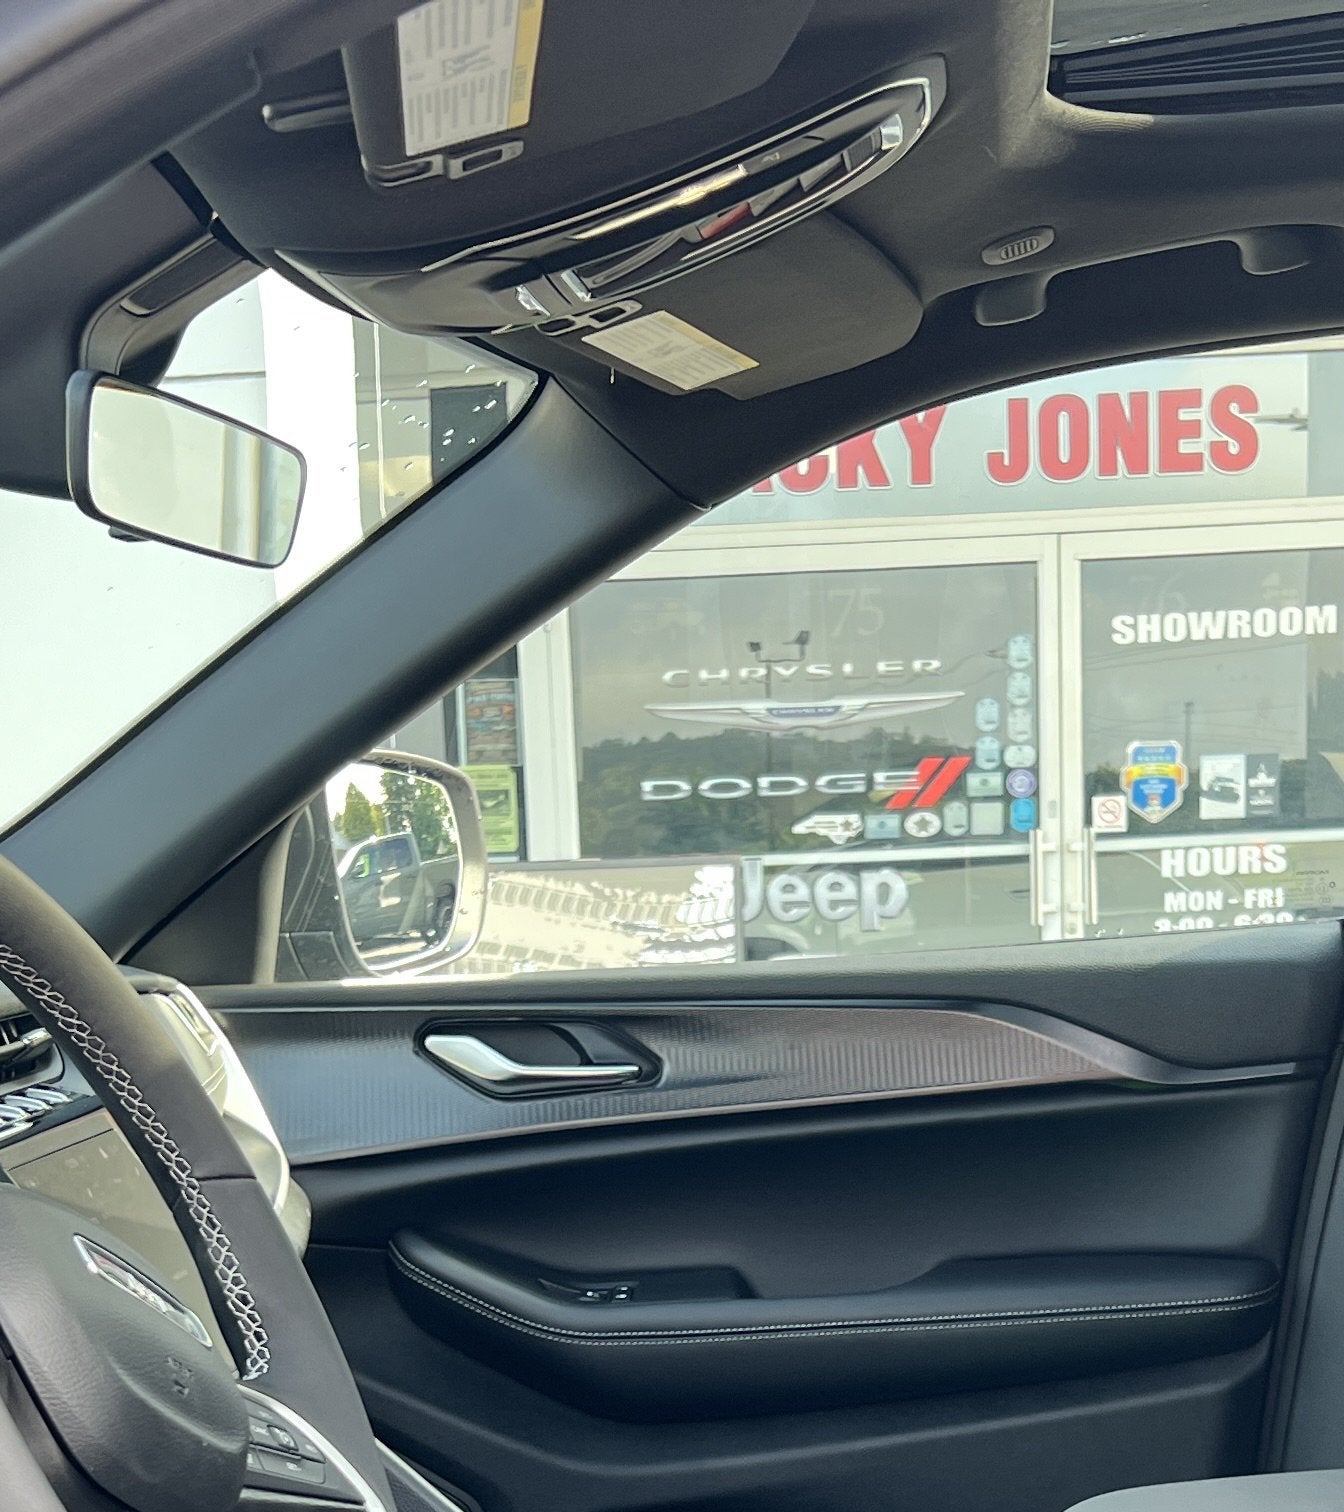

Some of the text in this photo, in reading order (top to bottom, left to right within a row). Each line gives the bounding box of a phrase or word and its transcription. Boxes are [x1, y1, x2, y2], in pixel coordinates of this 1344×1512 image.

[753, 384, 1258, 494] CKY JONES
[1111, 605, 1338, 645] SHOWROOM
[662, 659, 943, 688] CHRYSLER
[640, 770, 921, 801] DODGE
[1160, 844, 1288, 878] HOURS
[742, 857, 909, 932] Jeep
[1164, 890, 1224, 913] MON
[1244, 887, 1284, 909] FRI
